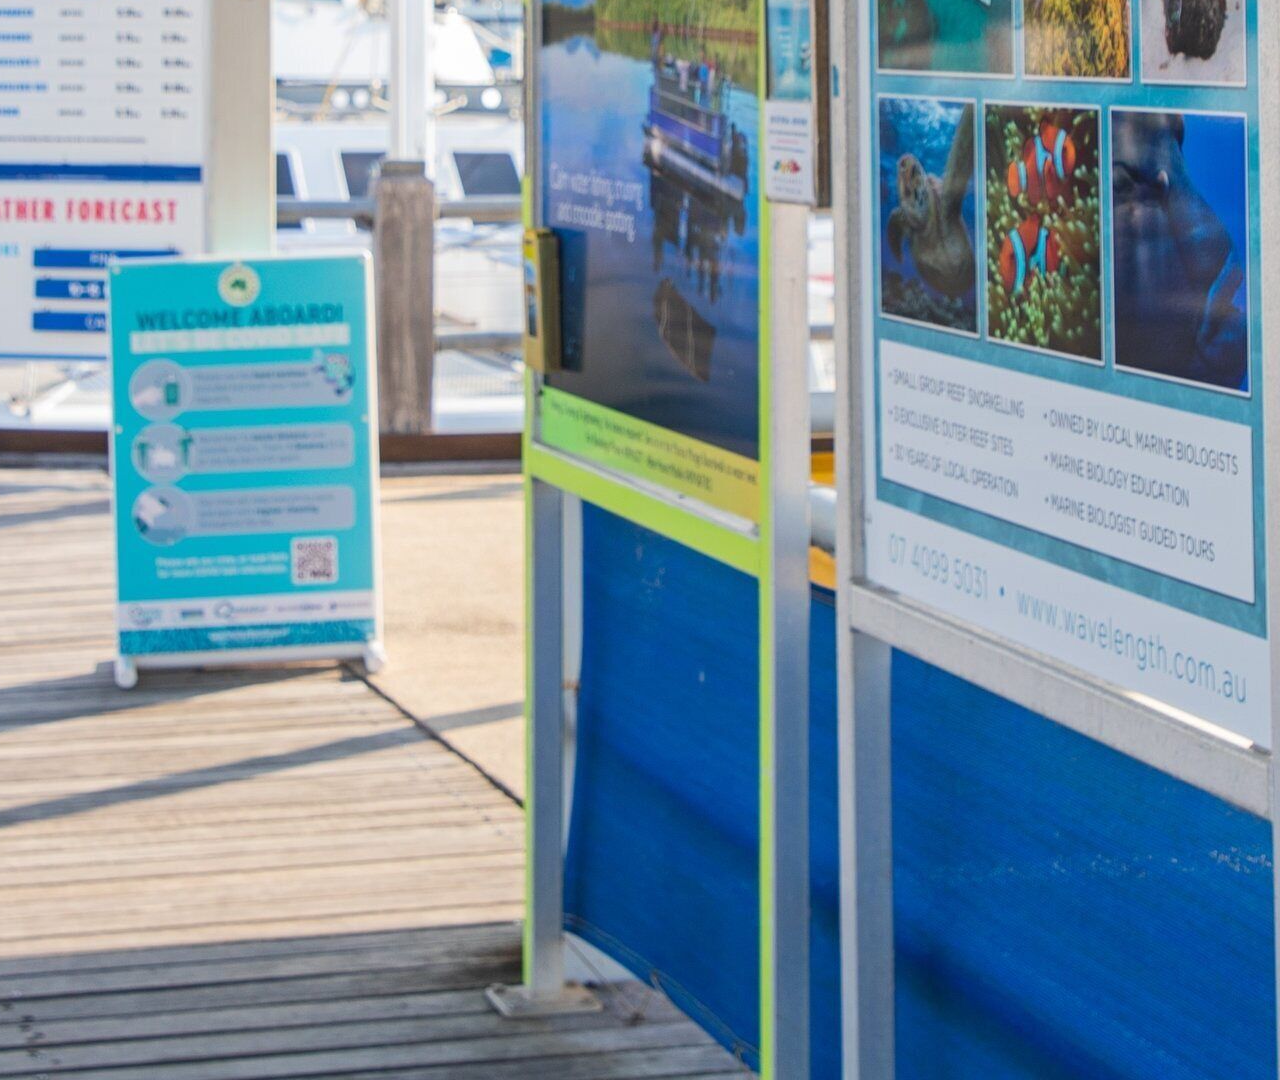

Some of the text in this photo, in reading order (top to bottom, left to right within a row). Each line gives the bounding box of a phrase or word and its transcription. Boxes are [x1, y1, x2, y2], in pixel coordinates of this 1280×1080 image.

[66, 200, 179, 224] FORECAST
[135, 307, 242, 331] WELCOME
[893, 368, 1026, 419] SMALL GROUP REEF SNORKELLING
[941, 419, 967, 442] OUTER
[969, 427, 990, 449] REEF
[990, 433, 1015, 457] SITES
[1049, 408, 1240, 476] OWNED BY LOCAL MARINE BIOLOGISTS
[943, 460, 969, 484] LOCAL
[971, 467, 1019, 499] OPERATION
[1050, 452, 1191, 508] MARINE BIOLOGY EDUCATION
[1050, 494, 1217, 563] MARINE BIOLOGIST GUIDED TOURS
[887, 533, 1248, 703] 07 4099 5031 www.wavelength.com.au
